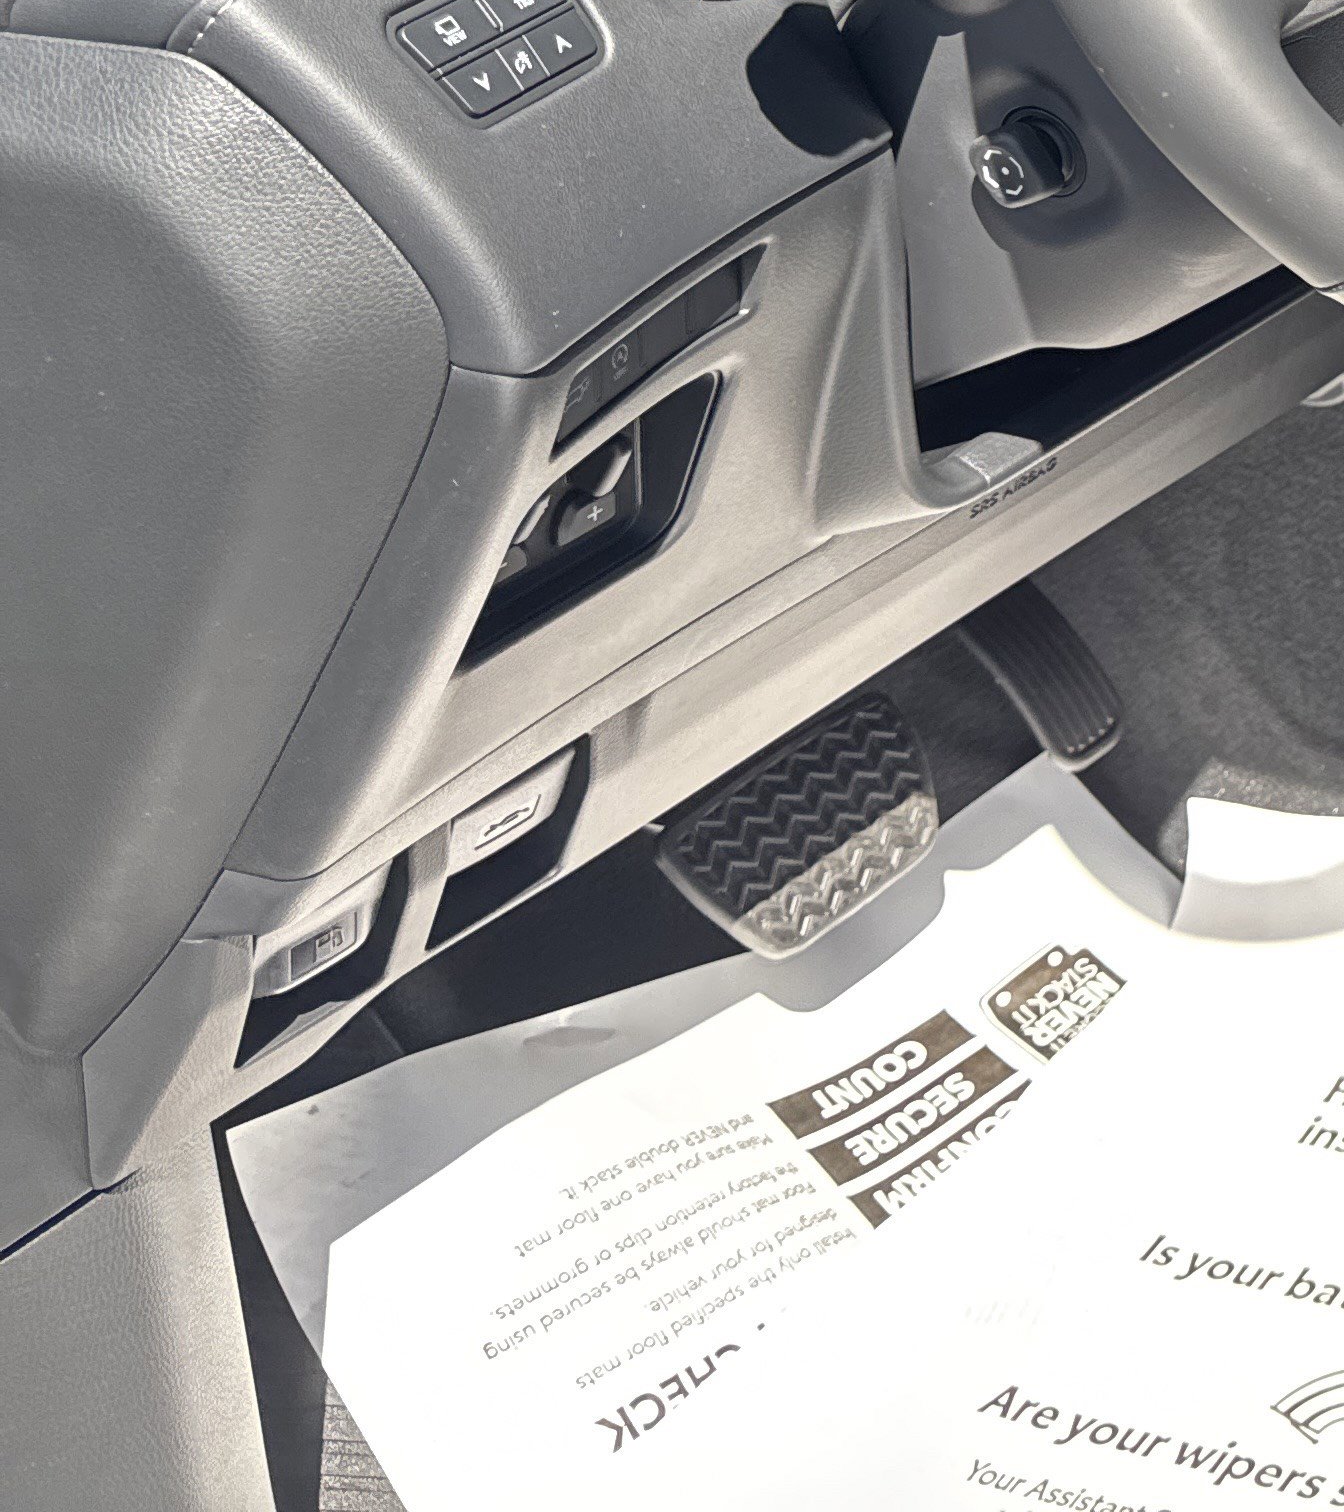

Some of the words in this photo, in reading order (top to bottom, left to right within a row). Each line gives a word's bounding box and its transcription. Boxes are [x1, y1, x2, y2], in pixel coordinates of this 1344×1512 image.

[1021, 970, 1120, 1046] NEVER
[811, 1037, 928, 1120] COUNT
[842, 1069, 977, 1167] SECURE
[624, 1139, 680, 1169] double
[676, 1152, 704, 1174] you
[578, 1164, 623, 1193] stack
[636, 1170, 677, 1193] have
[600, 1190, 632, 1211] one
[655, 1191, 726, 1231] retention
[558, 1207, 599, 1235] floor
[697, 1207, 751, 1245] should
[514, 1231, 552, 1258] mat
[615, 1228, 652, 1253] clips
[641, 1236, 694, 1271] always
[751, 1240, 774, 1257] for
[594, 1249, 612, 1266] or
[712, 1248, 747, 1280] your
[779, 1248, 811, 1272] only
[1138, 1234, 1180, 1267] Is
[1174, 1249, 1284, 1291] your
[490, 1258, 589, 1319] grommets.
[614, 1266, 640, 1285] be
[748, 1268, 777, 1288] the
[540, 1281, 611, 1333] secured
[670, 1285, 744, 1338] specified
[483, 1324, 536, 1360] using
[627, 1330, 669, 1360] floor
[576, 1356, 621, 1389] mats
[977, 1385, 1059, 1429] Are
[1053, 1406, 1172, 1457] your
[1175, 1441, 1327, 1499] wipers
[966, 1459, 1027, 1493] Your
